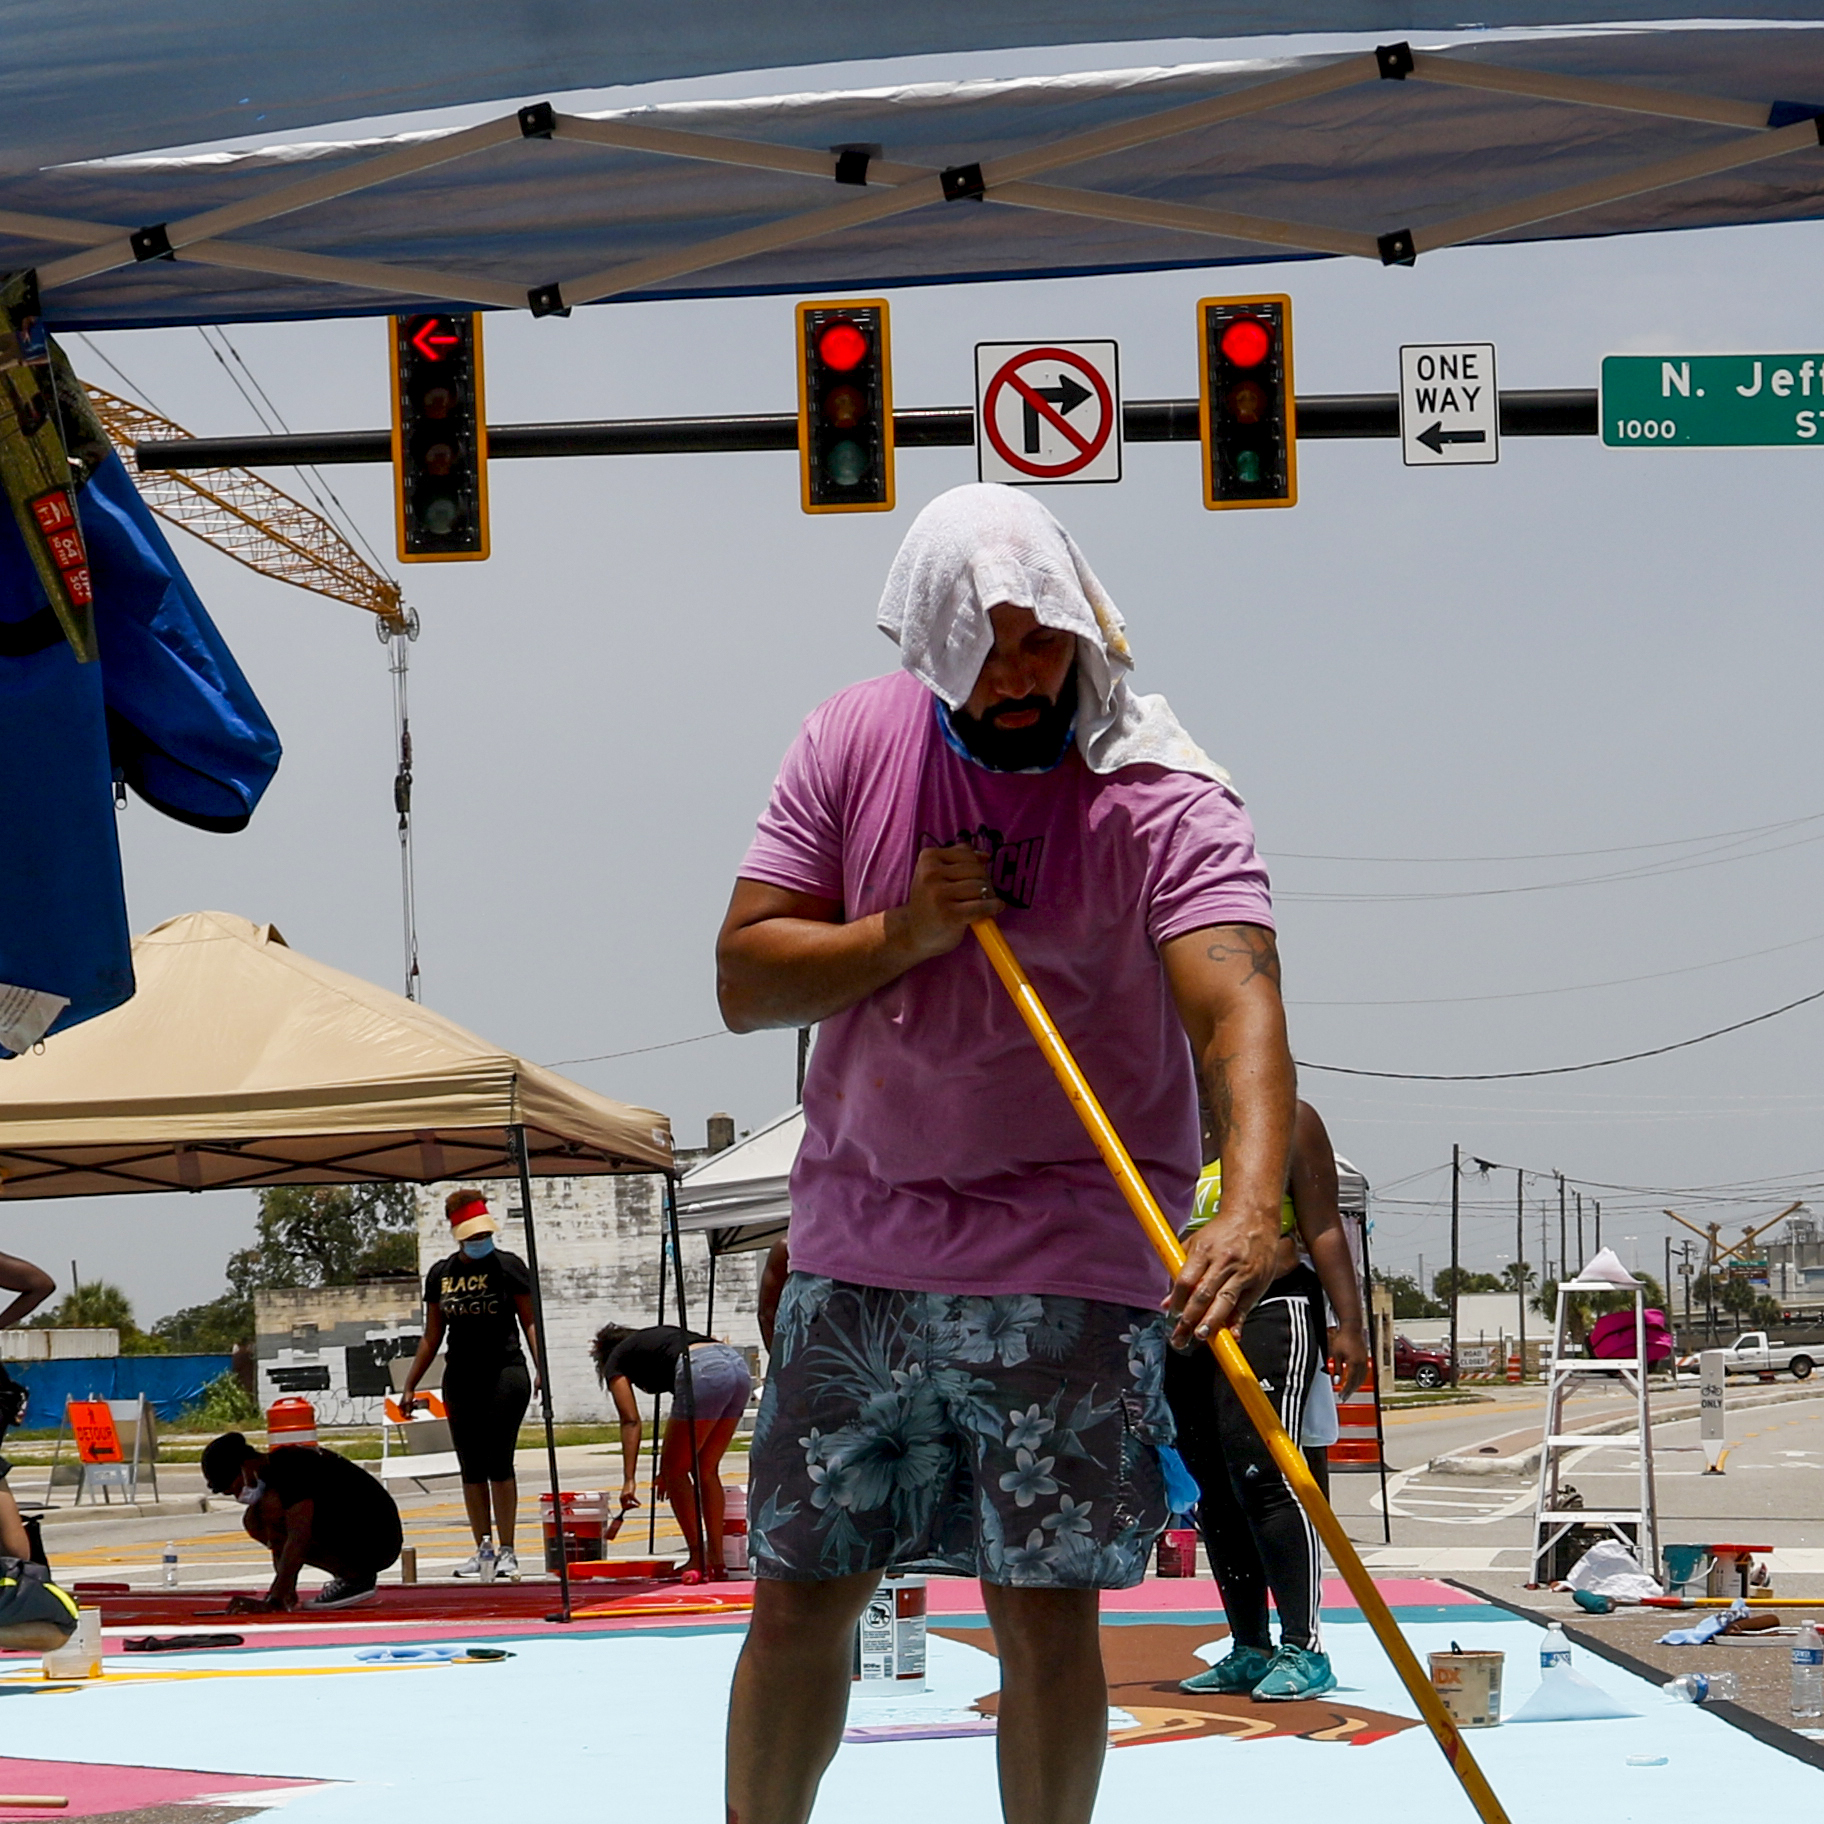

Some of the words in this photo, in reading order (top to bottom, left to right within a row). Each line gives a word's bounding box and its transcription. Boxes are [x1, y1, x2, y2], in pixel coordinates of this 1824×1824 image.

[1417, 353, 1479, 381] ONE
[1661, 362, 1705, 397] N.
[1415, 386, 1482, 414] WAY
[1617, 419, 1676, 439] 1000
[441, 1274, 488, 1294] BLACK
[1701, 1399, 1722, 1408] ONLY
[76, 1426, 113, 1441] DETOUR
